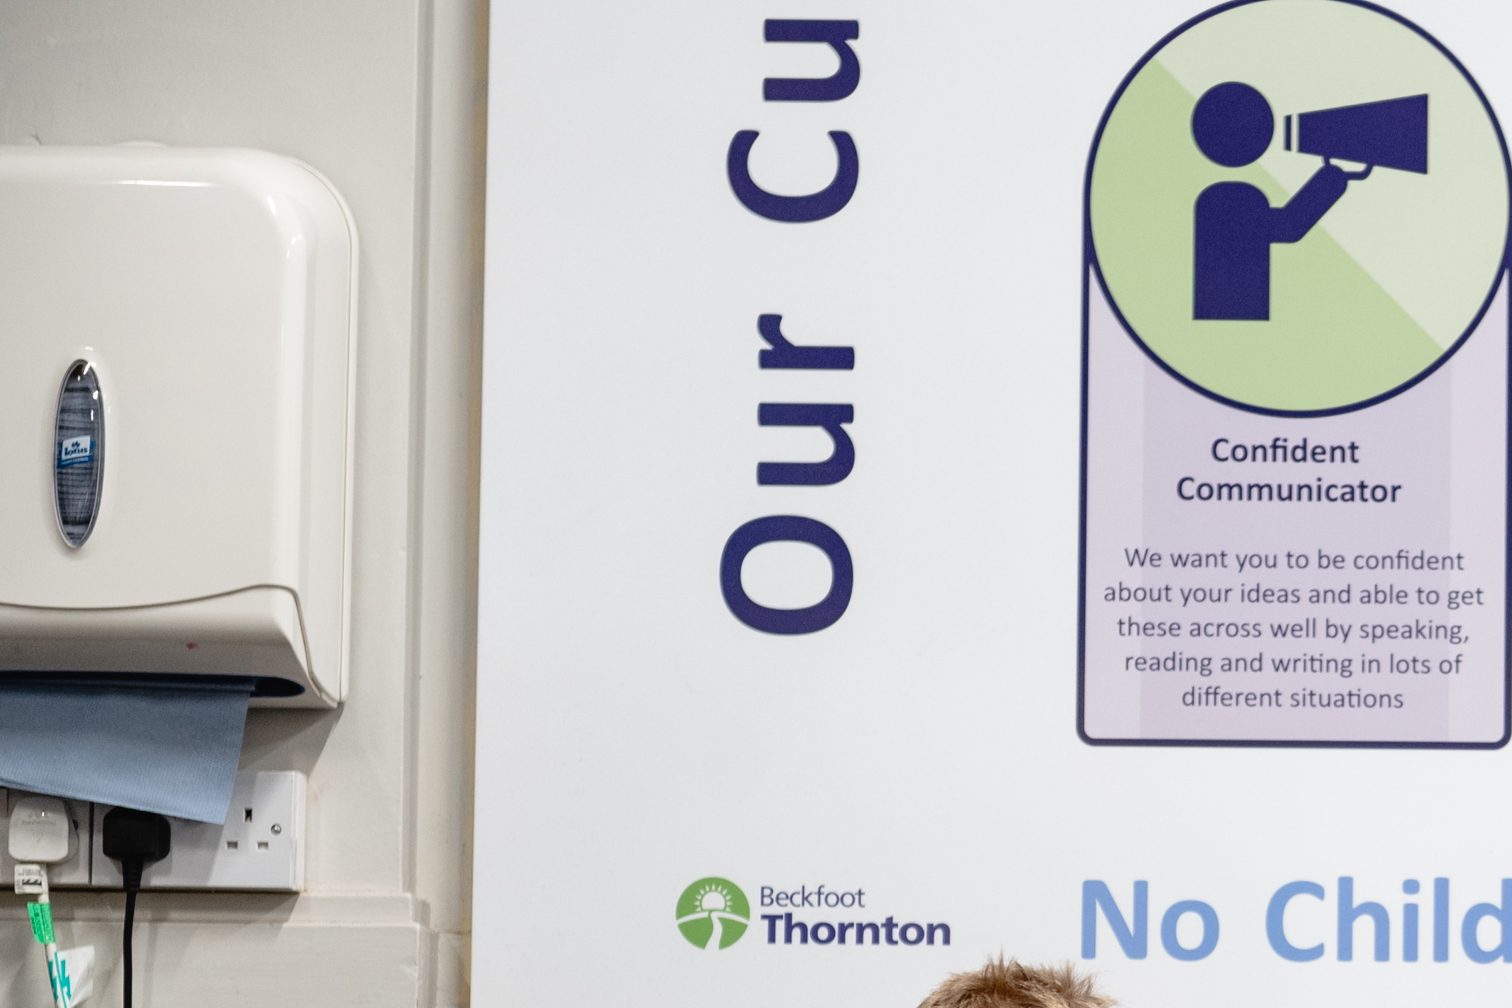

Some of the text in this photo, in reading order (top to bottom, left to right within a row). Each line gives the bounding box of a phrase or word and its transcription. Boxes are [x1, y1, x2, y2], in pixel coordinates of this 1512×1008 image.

[719, 18, 861, 636] Our Cu
[1210, 436, 1361, 465] Confident
[1175, 475, 1403, 504] Communicator
[1123, 547, 1465, 574] We want you to be confident
[1103, 580, 1485, 611] about your ideas and able to get
[1116, 615, 1470, 645] these across well by speaking,
[1124, 650, 1464, 679] reading and writing in lots of
[1181, 685, 1405, 709] different situations
[760, 884, 866, 909] Beckfoot
[760, 911, 951, 946] Thornton
[1081, 879, 1220, 963] No
